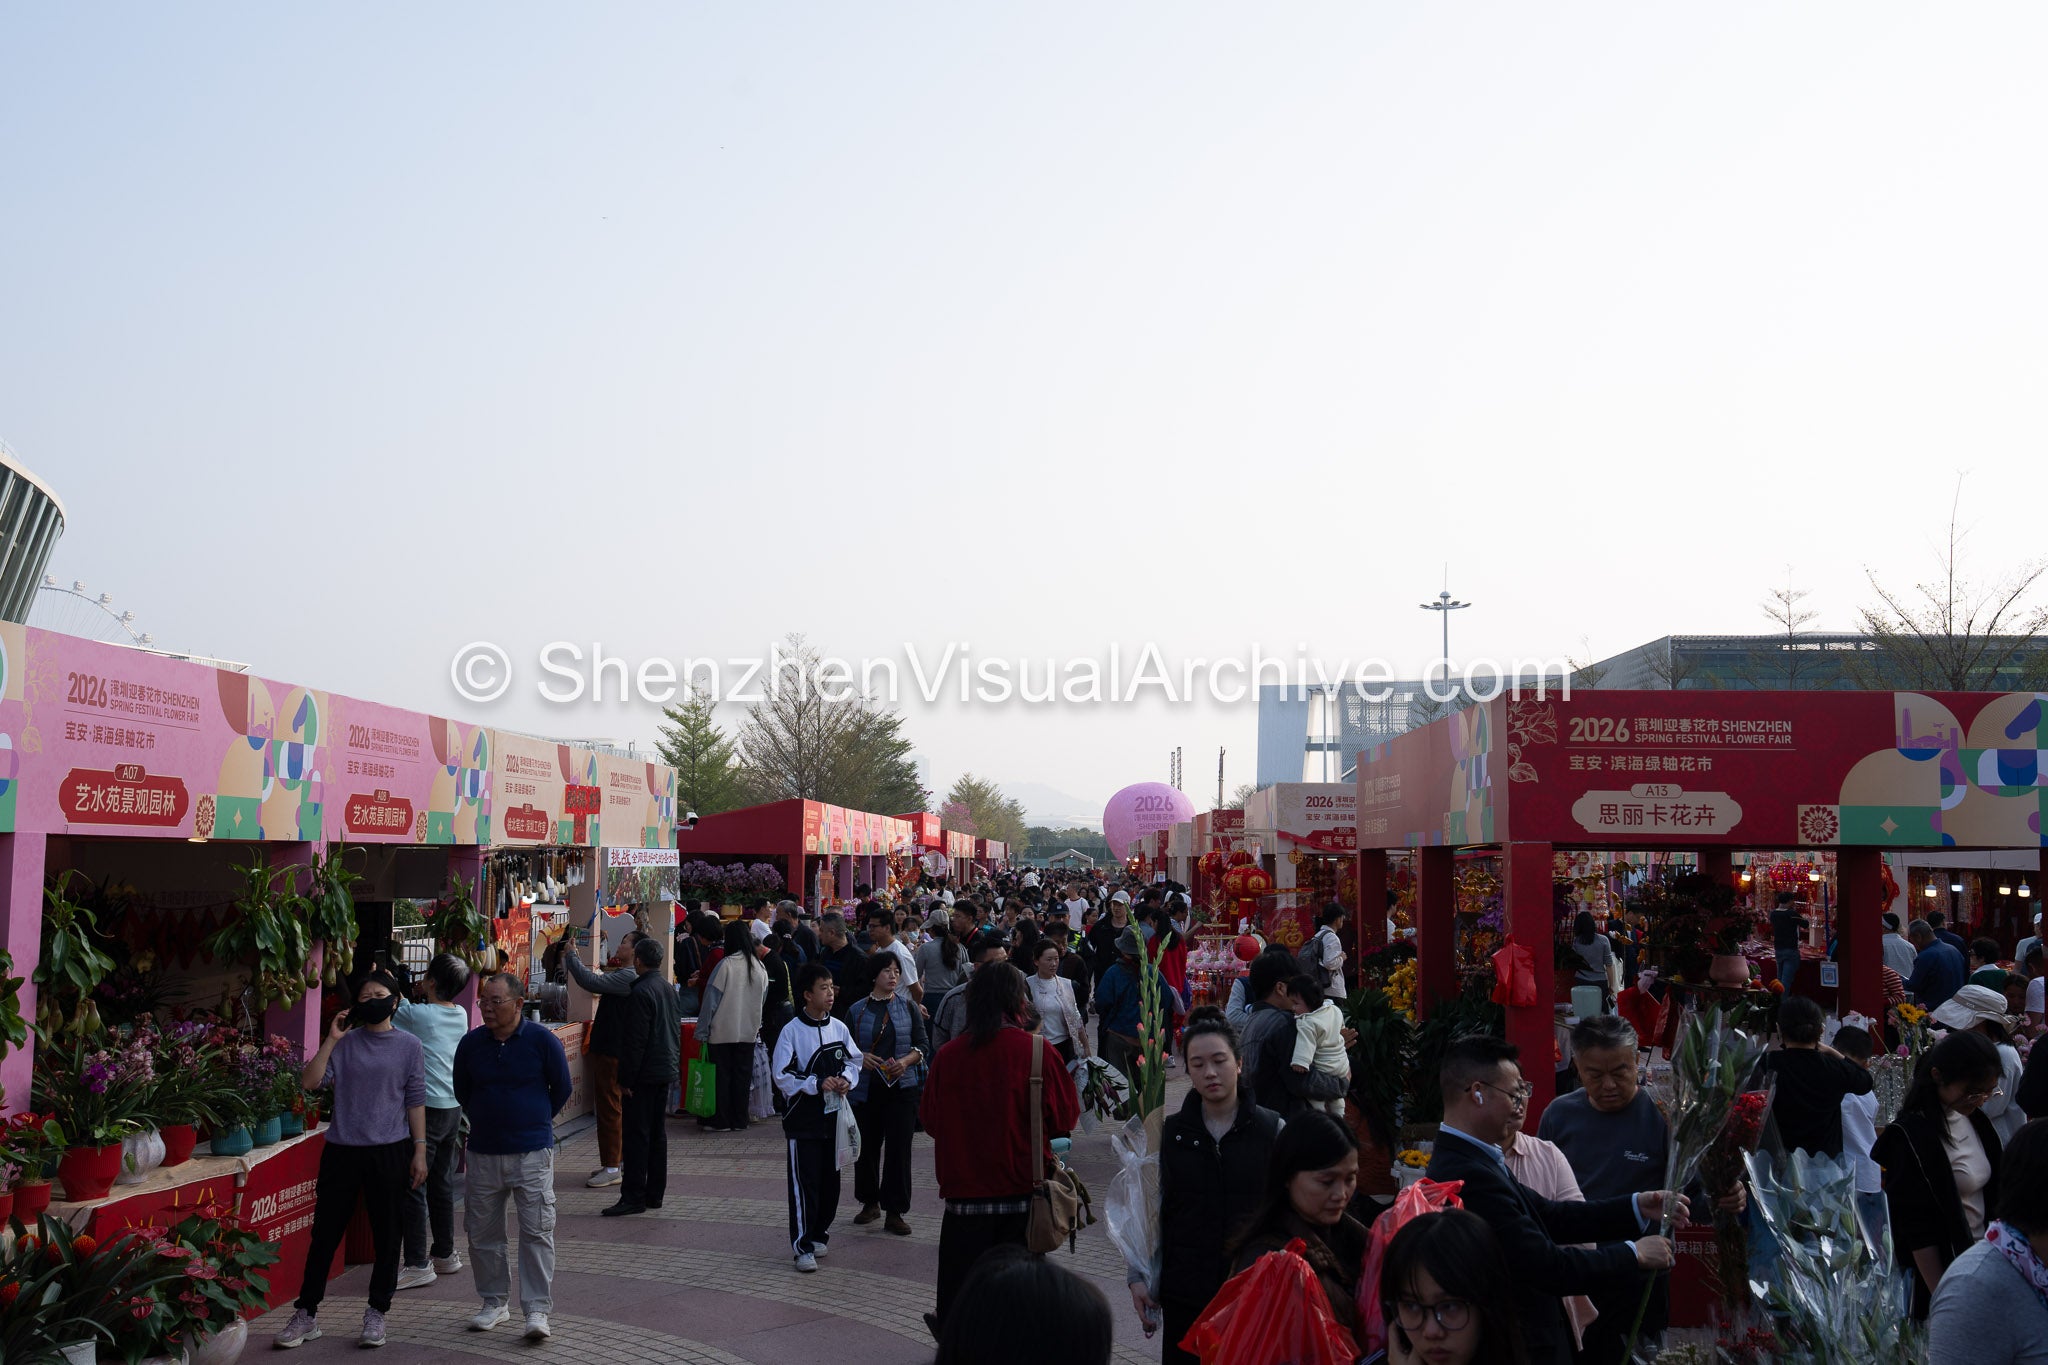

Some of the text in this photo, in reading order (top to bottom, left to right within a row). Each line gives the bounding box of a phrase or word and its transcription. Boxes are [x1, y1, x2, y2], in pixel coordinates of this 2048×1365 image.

[68, 672, 200, 710] 2026 深圳迎春花市 SHENZHEN
[110, 700, 199, 723] SPRING FESTIVAL FLOWER FAIR
[348, 724, 370, 750] 2026
[1569, 717, 1792, 742] 2026 深圳迎春花市 SHENZHEN
[1634, 734, 1792, 744] SPRING FESTIVAL FLOWER FAIR
[122, 766, 139, 779] A07
[1569, 755, 1712, 772] 宝安·滨海绿轴花市
[75, 783, 176, 816] 艺水苑景观园林
[1306, 796, 1333, 808] 2026
[1645, 785, 1668, 796] A13
[353, 804, 406, 827] 艺水苑景观园林
[1134, 796, 1174, 812] 2026
[1598, 803, 1716, 826] 思丽卡花卉
[1274, 919, 1304, 948] 福
[250, 1193, 277, 1224] 2026
